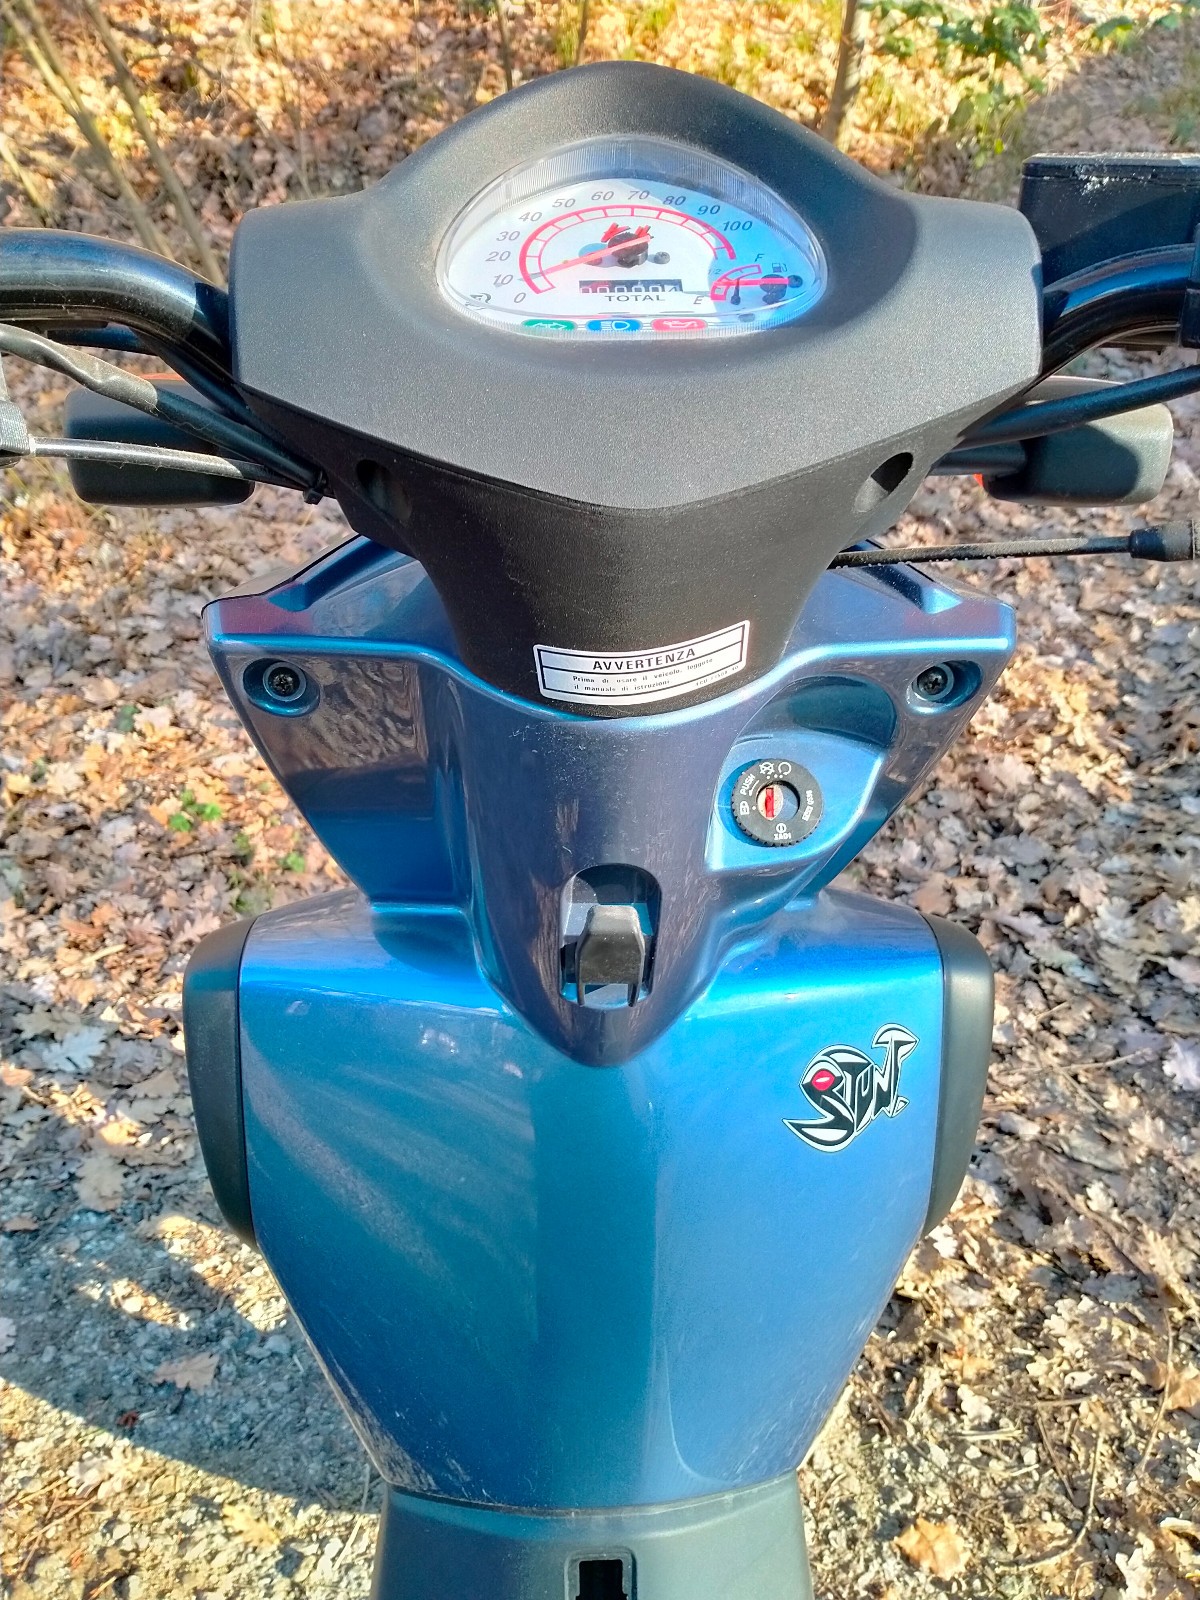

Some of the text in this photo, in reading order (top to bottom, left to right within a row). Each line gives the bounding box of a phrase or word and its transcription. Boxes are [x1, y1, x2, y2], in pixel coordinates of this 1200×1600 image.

[591, 190, 615, 201] 60
[627, 190, 650, 200] 70
[552, 198, 576, 208] 50
[662, 196, 687, 206] 80
[697, 205, 721, 215] 90
[518, 211, 543, 222] 40
[722, 220, 753, 232] 100
[496, 230, 521, 242] 30
[485, 250, 511, 262] 20
[754, 253, 765, 262] F
[493, 273, 514, 286] 10
[513, 292, 527, 304] 0
[604, 294, 666, 302] TOTAL
[693, 295, 705, 305] E
[592, 648, 696, 671] AVVERTENZA
[573, 675, 595, 683] Prima
[740, 773, 756, 796] PUSH
